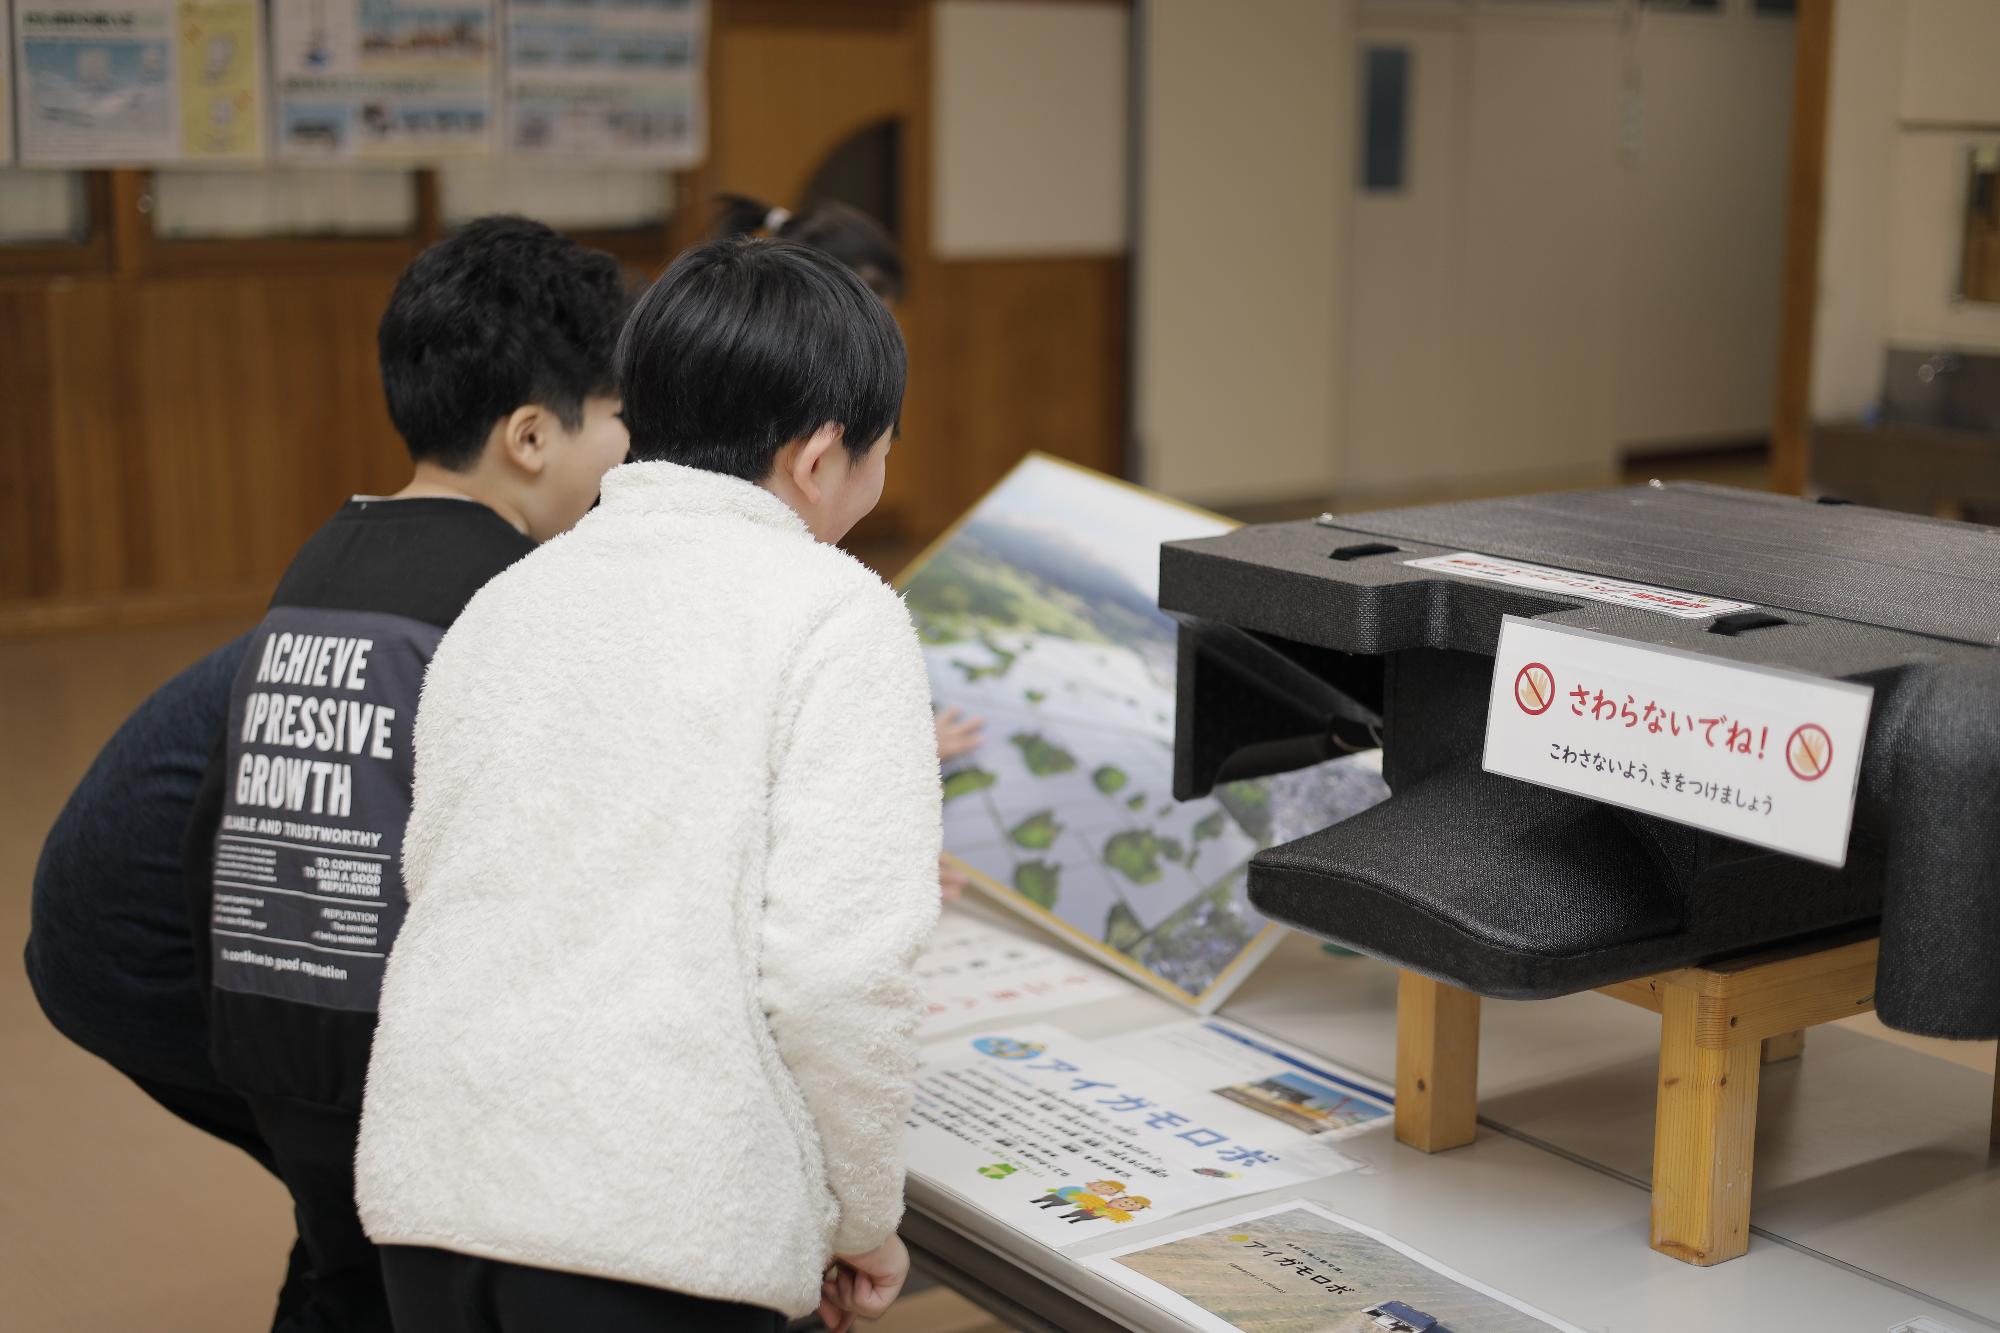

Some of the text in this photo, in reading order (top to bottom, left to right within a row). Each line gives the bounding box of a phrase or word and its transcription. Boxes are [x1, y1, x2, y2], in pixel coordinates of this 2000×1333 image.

[256, 632, 374, 691] ACHIEVE
[1569, 684, 1768, 760] さわらないでね!
[235, 752, 352, 818] GROWTH
[1549, 742, 1774, 815] こわさないよう、きをつけましょう
[258, 817, 283, 836] AND
[282, 820, 383, 848] TRUSTWORTHY
[314, 856, 383, 875] TO CONTINUE
[316, 868, 340, 881] GAIN
[350, 872, 382, 886] GOOD
[317, 880, 381, 897] REPUTATION
[321, 907, 379, 924] REPUTATION
[1025, 1058, 1281, 1168] アイガモロボ
[1243, 1240, 1356, 1295] アイガモロボ
